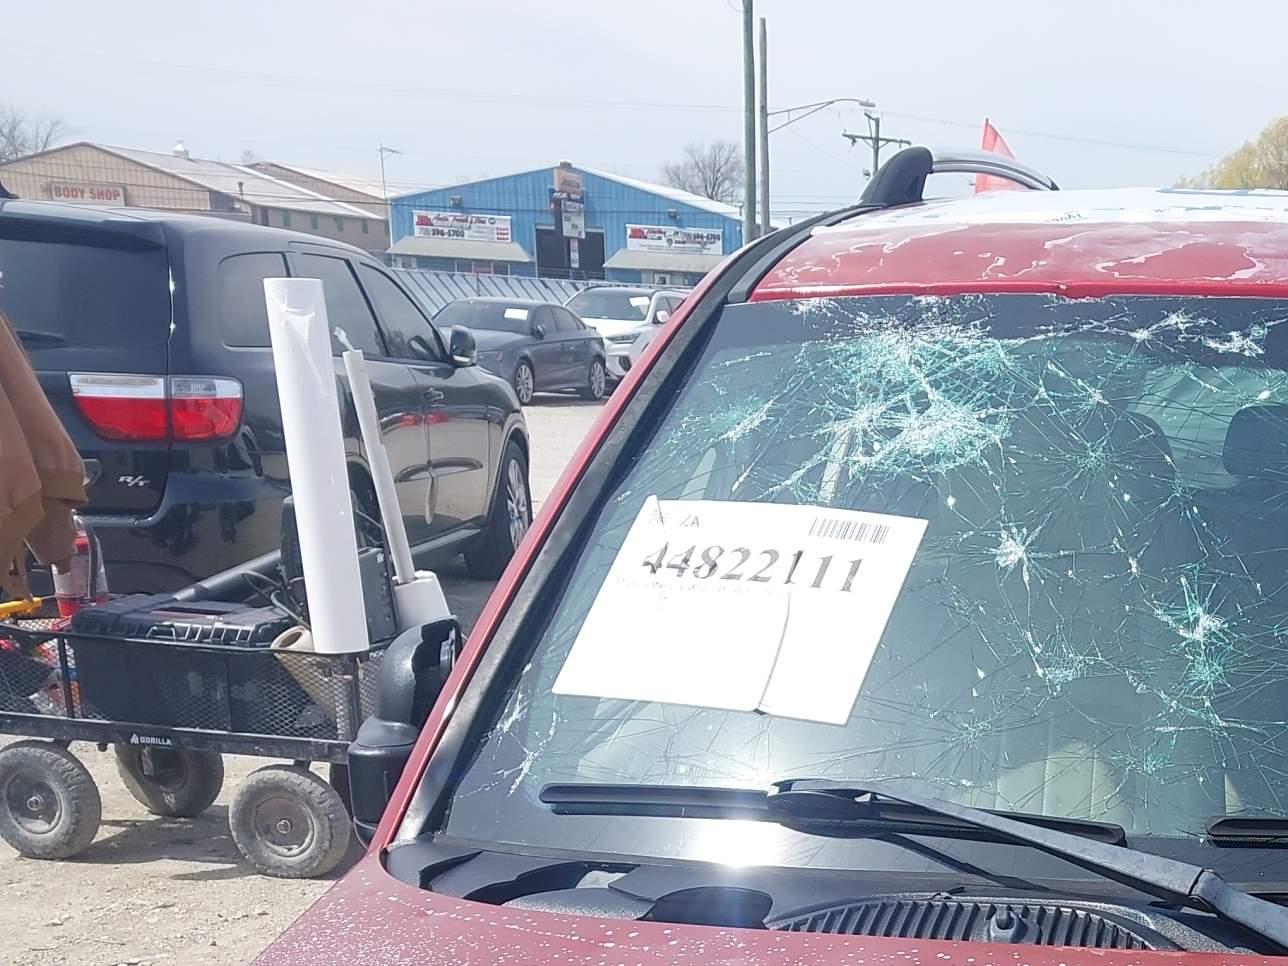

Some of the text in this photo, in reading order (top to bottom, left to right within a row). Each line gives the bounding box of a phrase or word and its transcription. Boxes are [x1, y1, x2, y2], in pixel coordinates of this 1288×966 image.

[54, 186, 121, 200] BODY SHOP
[118, 475, 151, 487] R/T
[641, 541, 864, 593] 44822111
[139, 736, 173, 746] GORILLA
